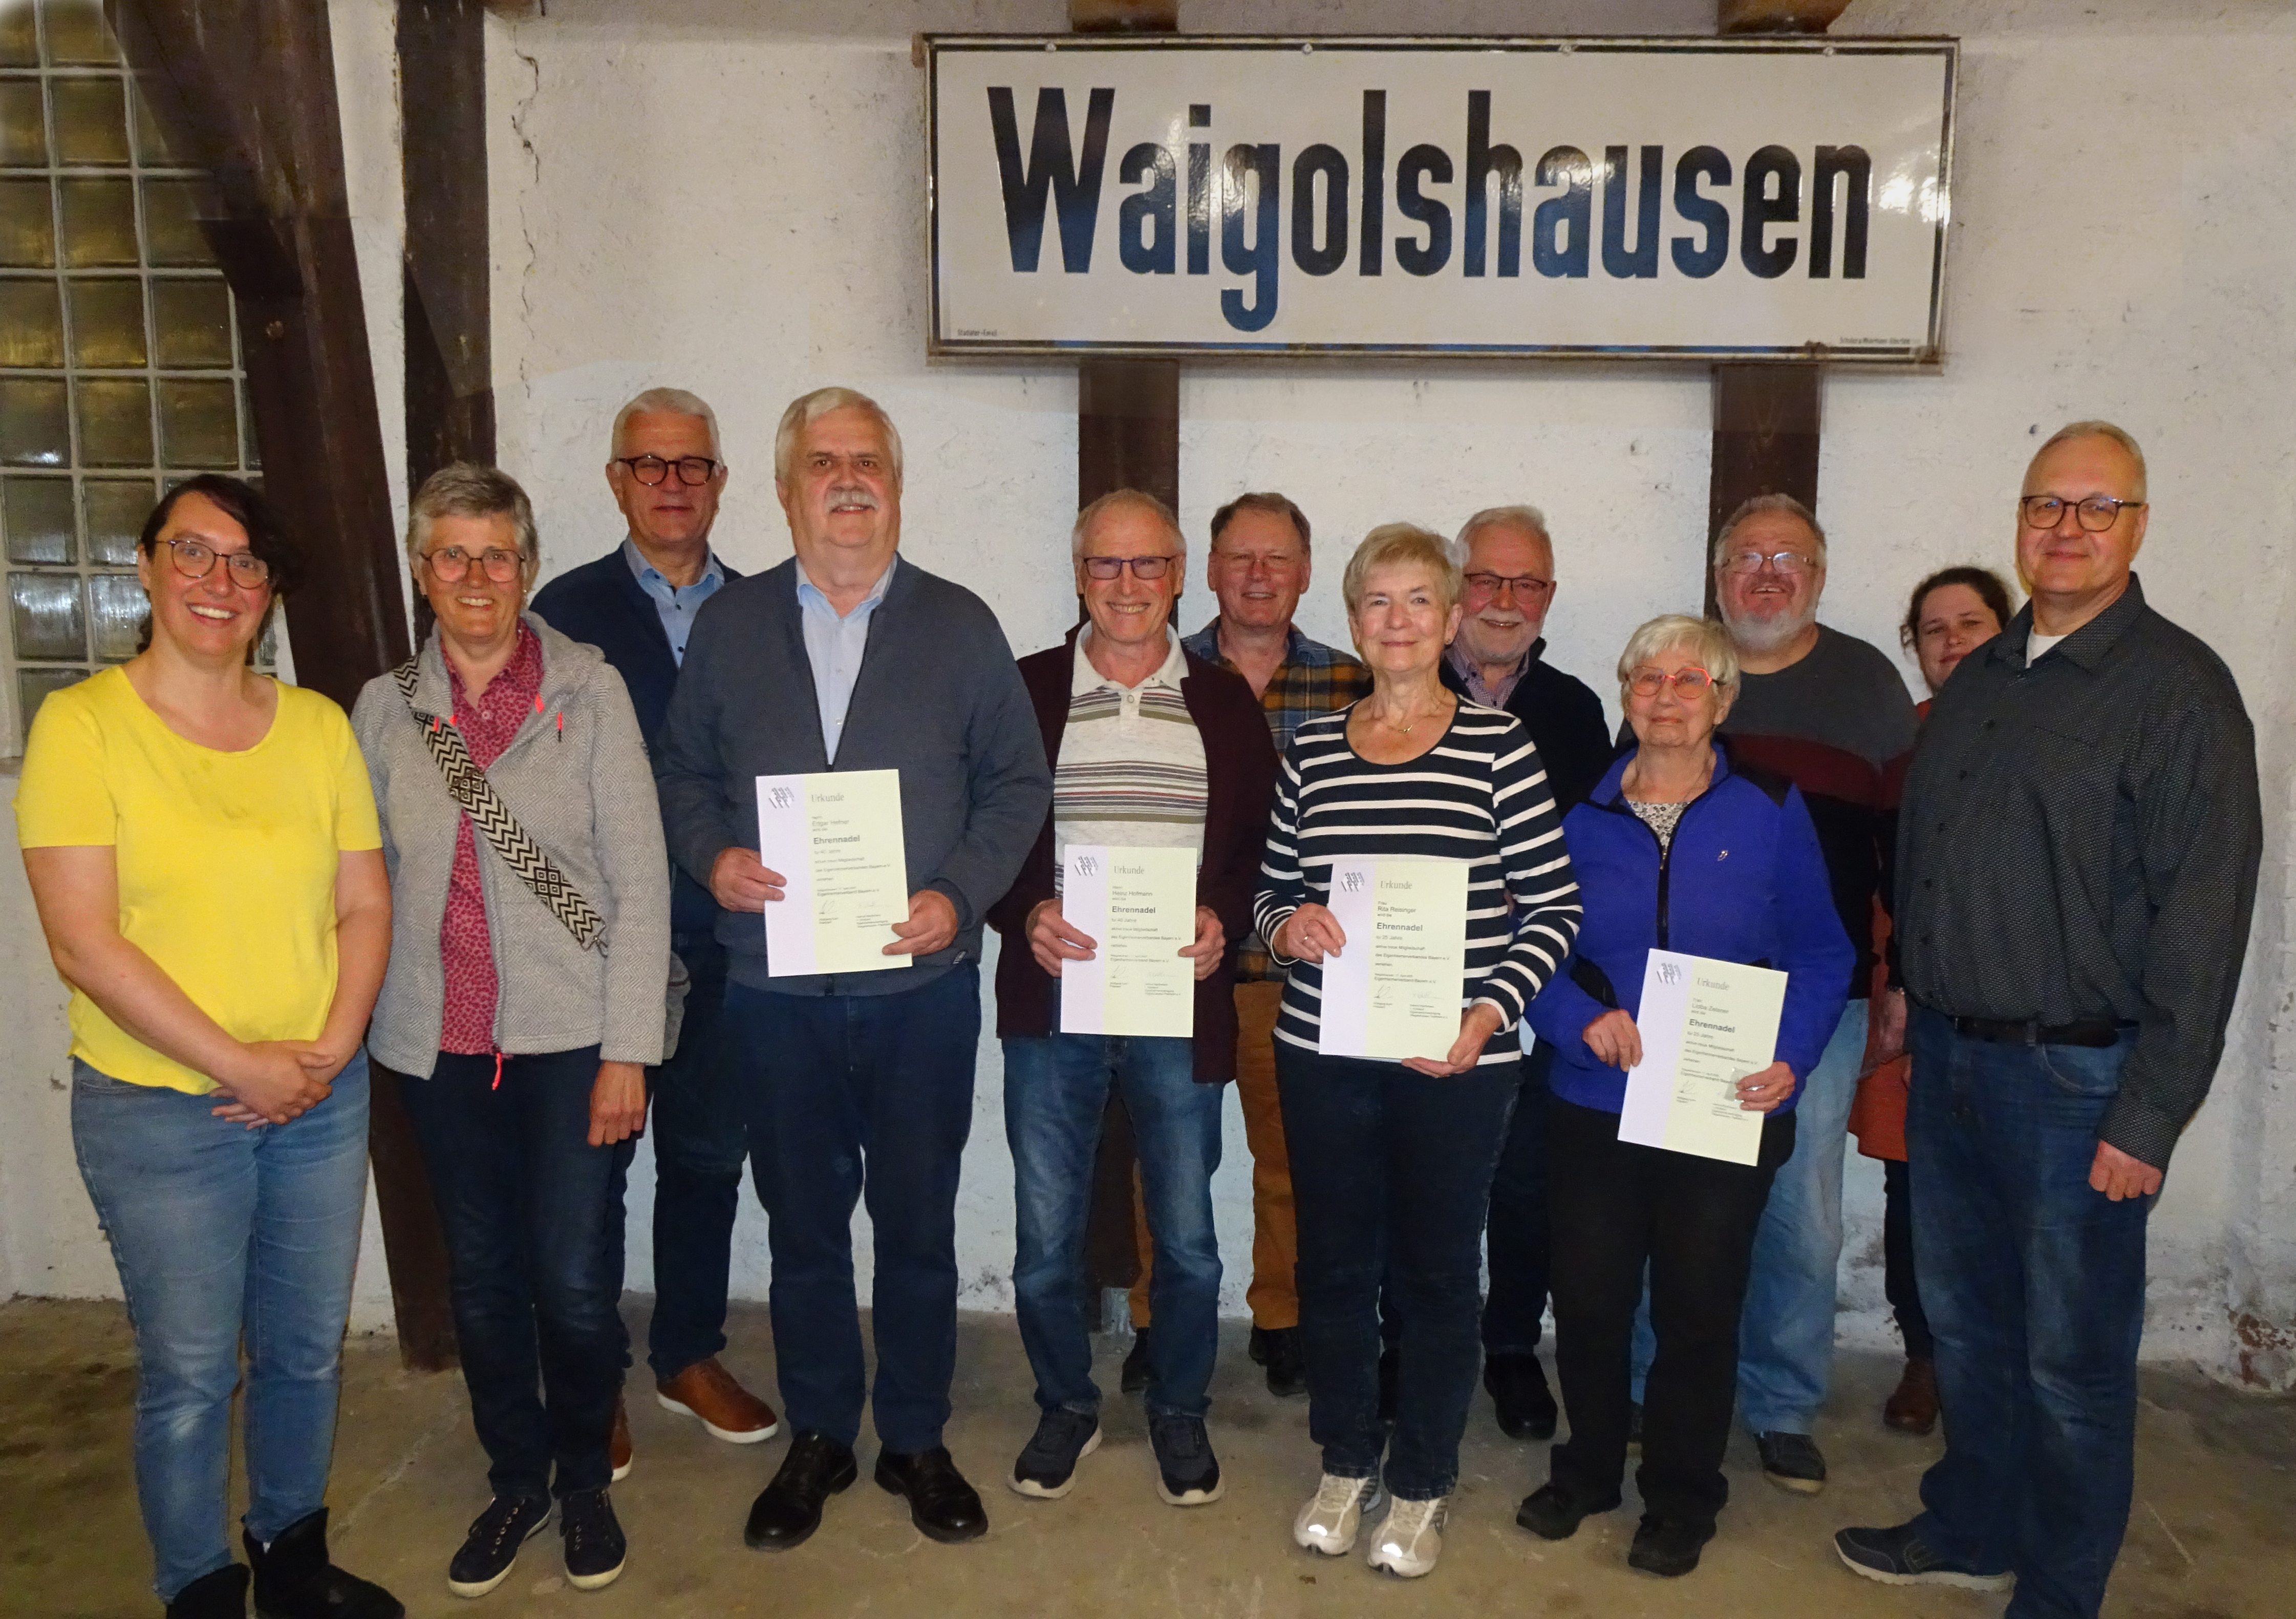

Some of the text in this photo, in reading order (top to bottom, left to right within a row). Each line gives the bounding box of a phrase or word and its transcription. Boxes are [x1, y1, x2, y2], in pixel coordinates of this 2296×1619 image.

[986, 86, 1872, 333] Waigolshausen
[811, 793, 845, 802] Urkunde
[813, 835, 861, 845] Ehrennadel
[1114, 865, 1145, 875] Urkunde
[1380, 880, 1413, 890] Urkunde
[1111, 906, 1156, 914] Ehrennadel
[1376, 922, 1423, 931] Ehrennadel
[1697, 977, 1730, 991] Urkunde
[1689, 1018, 1735, 1033] Ehrennadel
